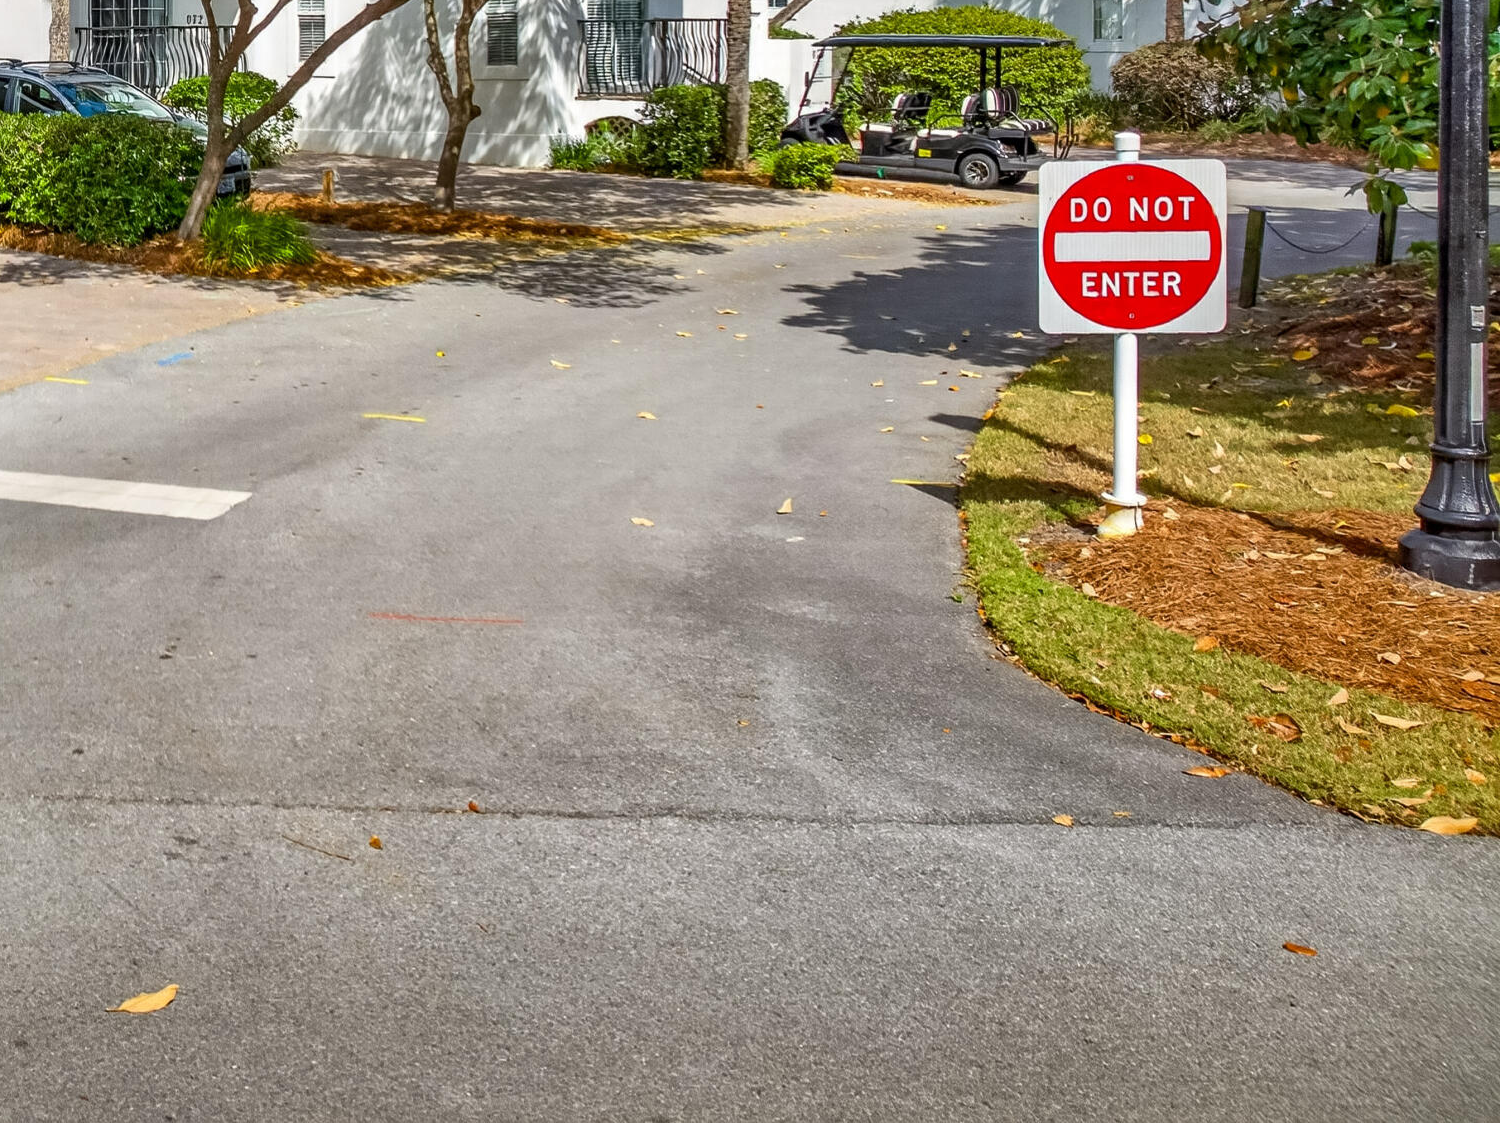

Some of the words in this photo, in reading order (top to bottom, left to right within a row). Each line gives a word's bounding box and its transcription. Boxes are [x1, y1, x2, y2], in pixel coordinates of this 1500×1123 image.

[1070, 196, 1112, 222] DO
[1129, 196, 1196, 222] NOT
[1081, 271, 1182, 298] ENTER
